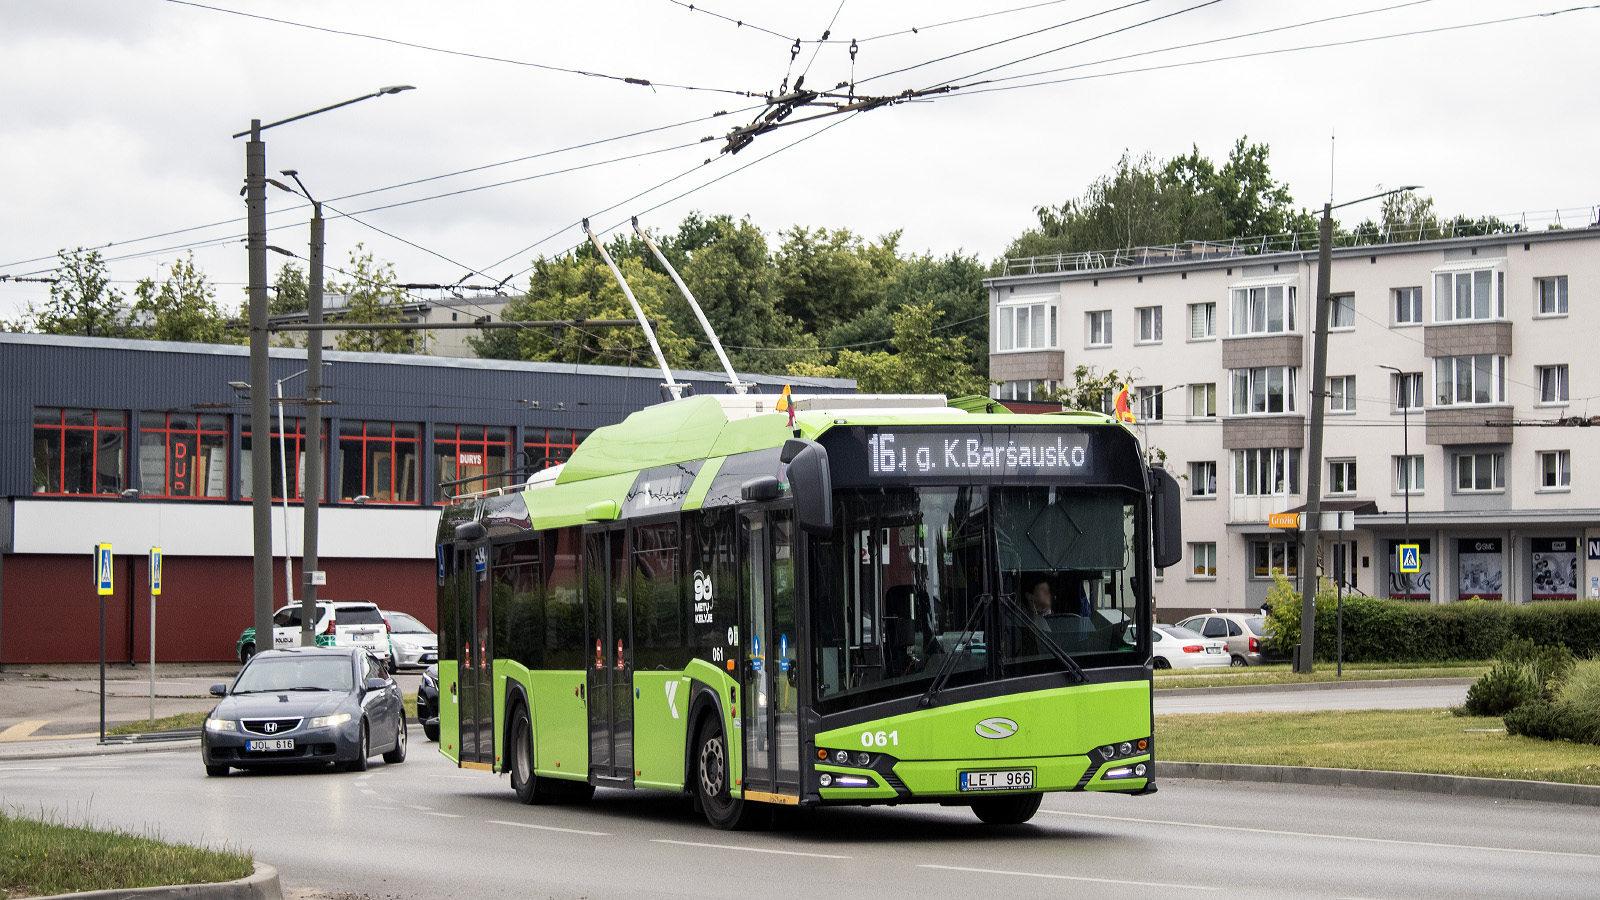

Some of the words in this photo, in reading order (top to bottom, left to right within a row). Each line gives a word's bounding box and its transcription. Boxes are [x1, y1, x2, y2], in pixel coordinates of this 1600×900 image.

[459, 454, 482, 465] DURYS
[868, 433, 896, 472] 16
[916, 447, 936, 472] g.
[1271, 515, 1294, 525] Grožio
[694, 613, 713, 624] KELYJE
[712, 647, 724, 662] 061
[251, 741, 270, 750] JOL
[276, 740, 293, 749] 616
[861, 730, 899, 747] 061
[969, 773, 998, 787] LET
[1006, 772, 1031, 785] 966
